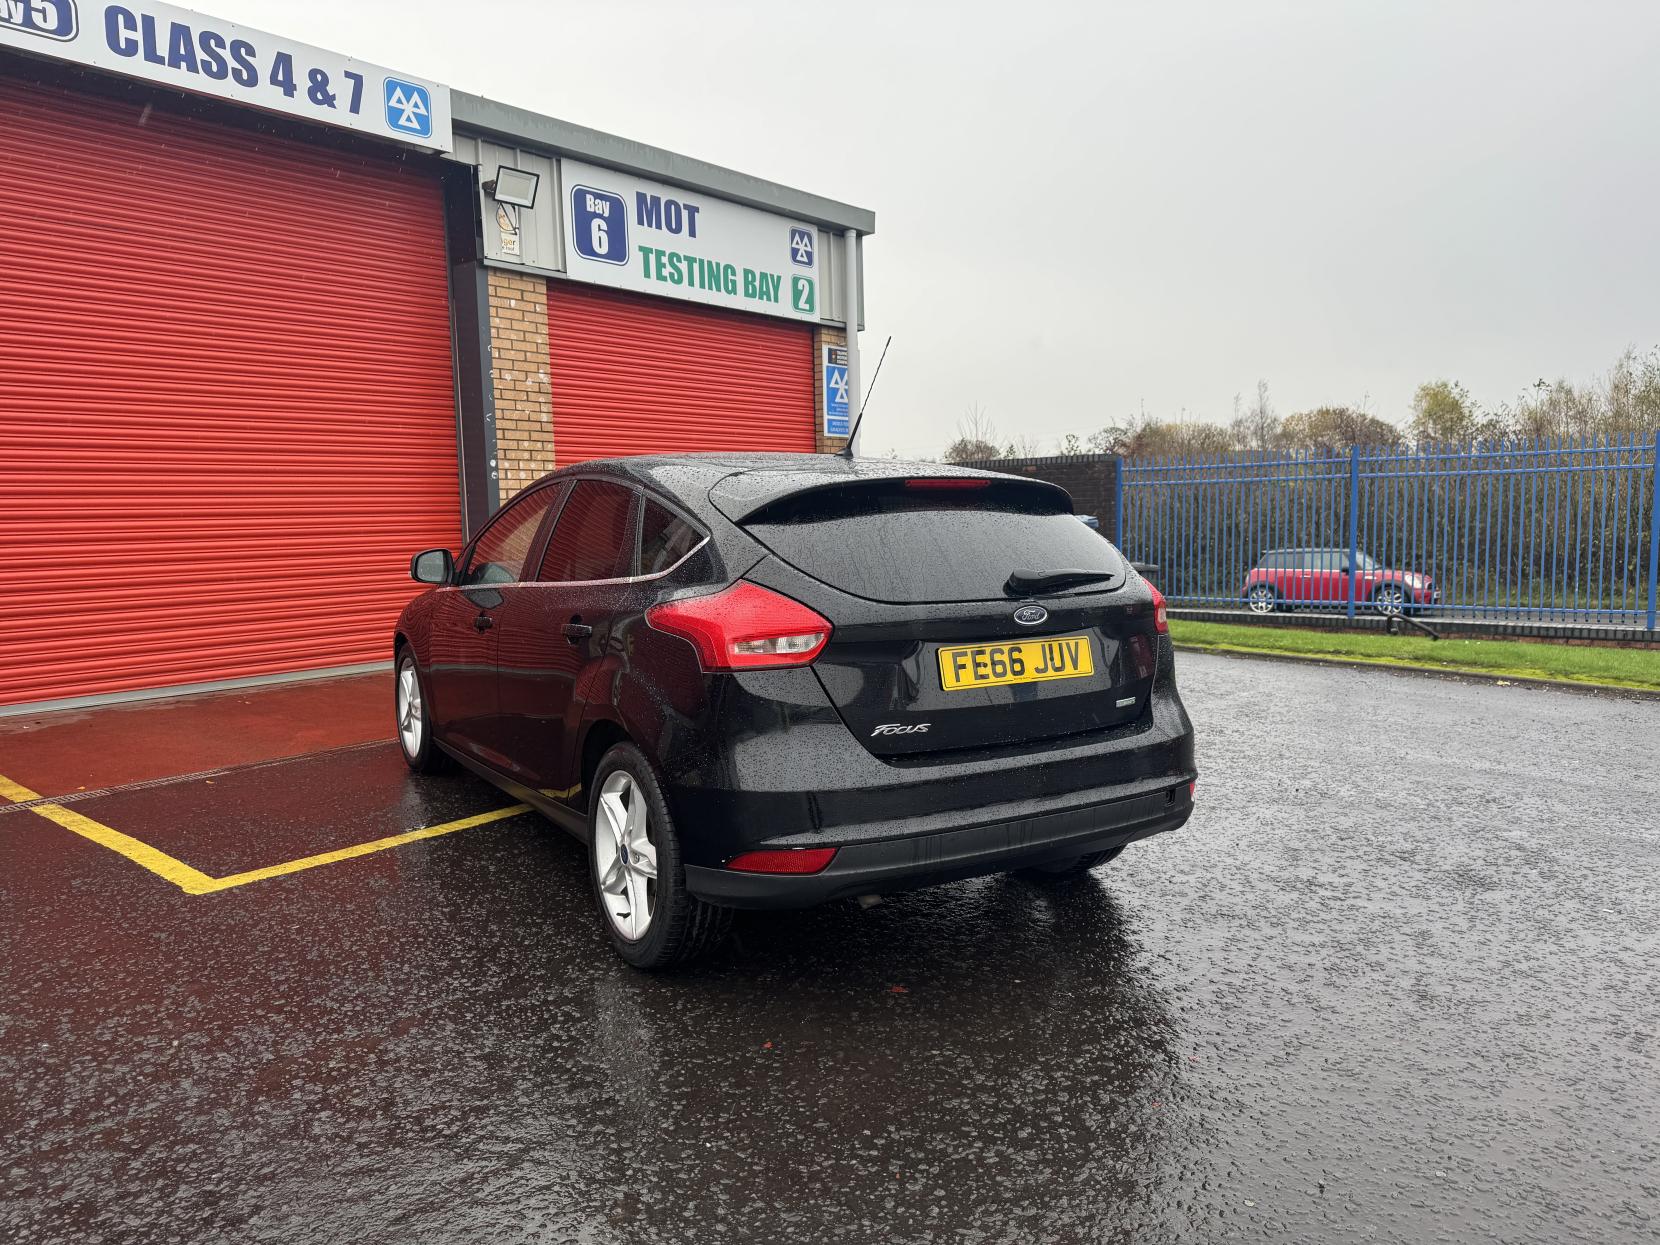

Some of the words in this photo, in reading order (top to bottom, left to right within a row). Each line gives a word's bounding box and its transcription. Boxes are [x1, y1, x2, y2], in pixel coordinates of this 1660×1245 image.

[0, 0, 24, 24] ay
[31, 0, 58, 30] 5
[104, 5, 259, 88] CLASS
[269, 51, 297, 99] 4
[307, 67, 337, 109] &
[343, 70, 364, 115] 7
[585, 193, 610, 217] Bay
[635, 191, 700, 239] MOT
[590, 218, 609, 255] 6
[638, 245, 737, 296] TESTING
[743, 268, 782, 304] BAY
[797, 278, 812, 311] 2
[952, 645, 1025, 683] FE66
[1034, 641, 1080, 675] JUV
